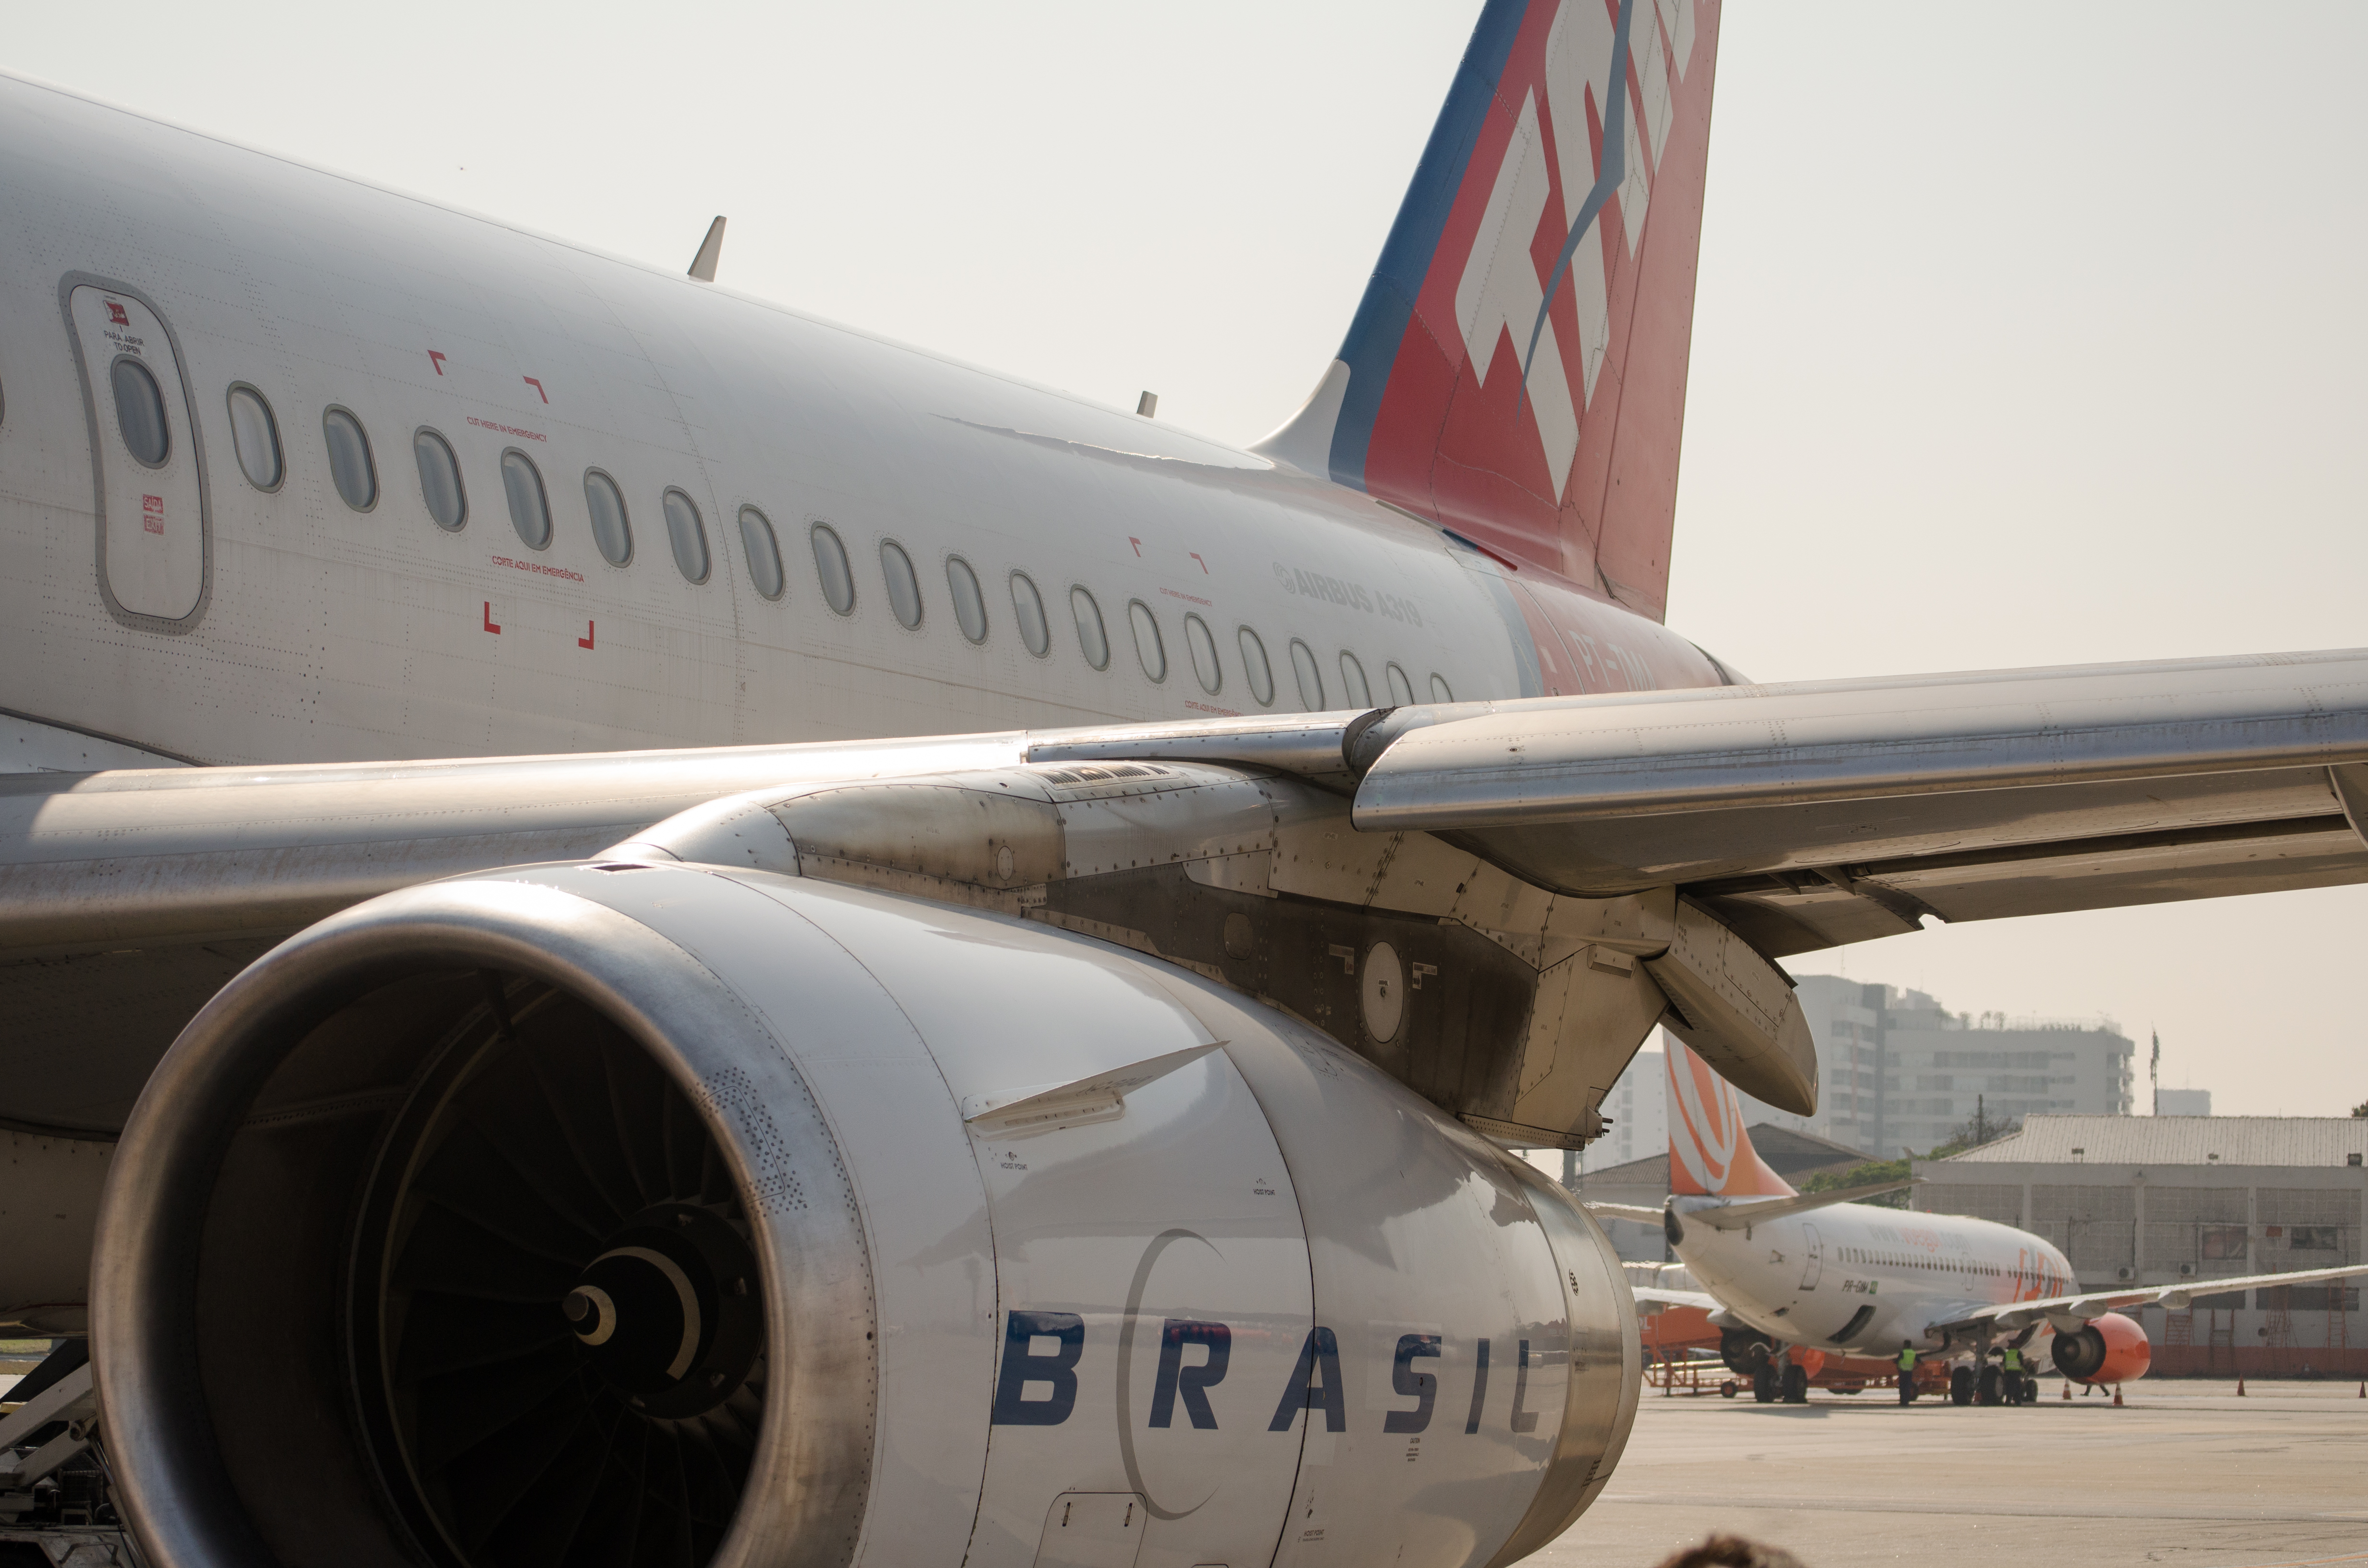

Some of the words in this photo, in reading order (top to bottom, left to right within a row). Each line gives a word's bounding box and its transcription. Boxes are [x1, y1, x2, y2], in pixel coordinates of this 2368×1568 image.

[104, 330, 123, 342] PARA
[125, 335, 145, 346] ABRIR
[114, 342, 123, 351] TO
[123, 344, 142, 355] OPEN
[467, 416, 480, 427] CUT
[481, 419, 499, 431] HERE
[499, 424, 507, 433] IN
[507, 426, 547, 442] EMERGENCY
[144, 496, 162, 511] SAÍDA
[492, 555, 514, 568] CORTE
[515, 560, 531, 572] AQUI
[531, 564, 542, 574] EM
[542, 565, 585, 583] EMERGÊNCIA
[1293, 567, 1374, 614] AIRBUS
[1374, 589, 1423, 628] A319
[1185, 700, 1199, 710] CORTE
[1199, 704, 1210, 712] AQUI
[1210, 706, 1217, 714] EM
[991, 1310, 1539, 1434] BRASIL
